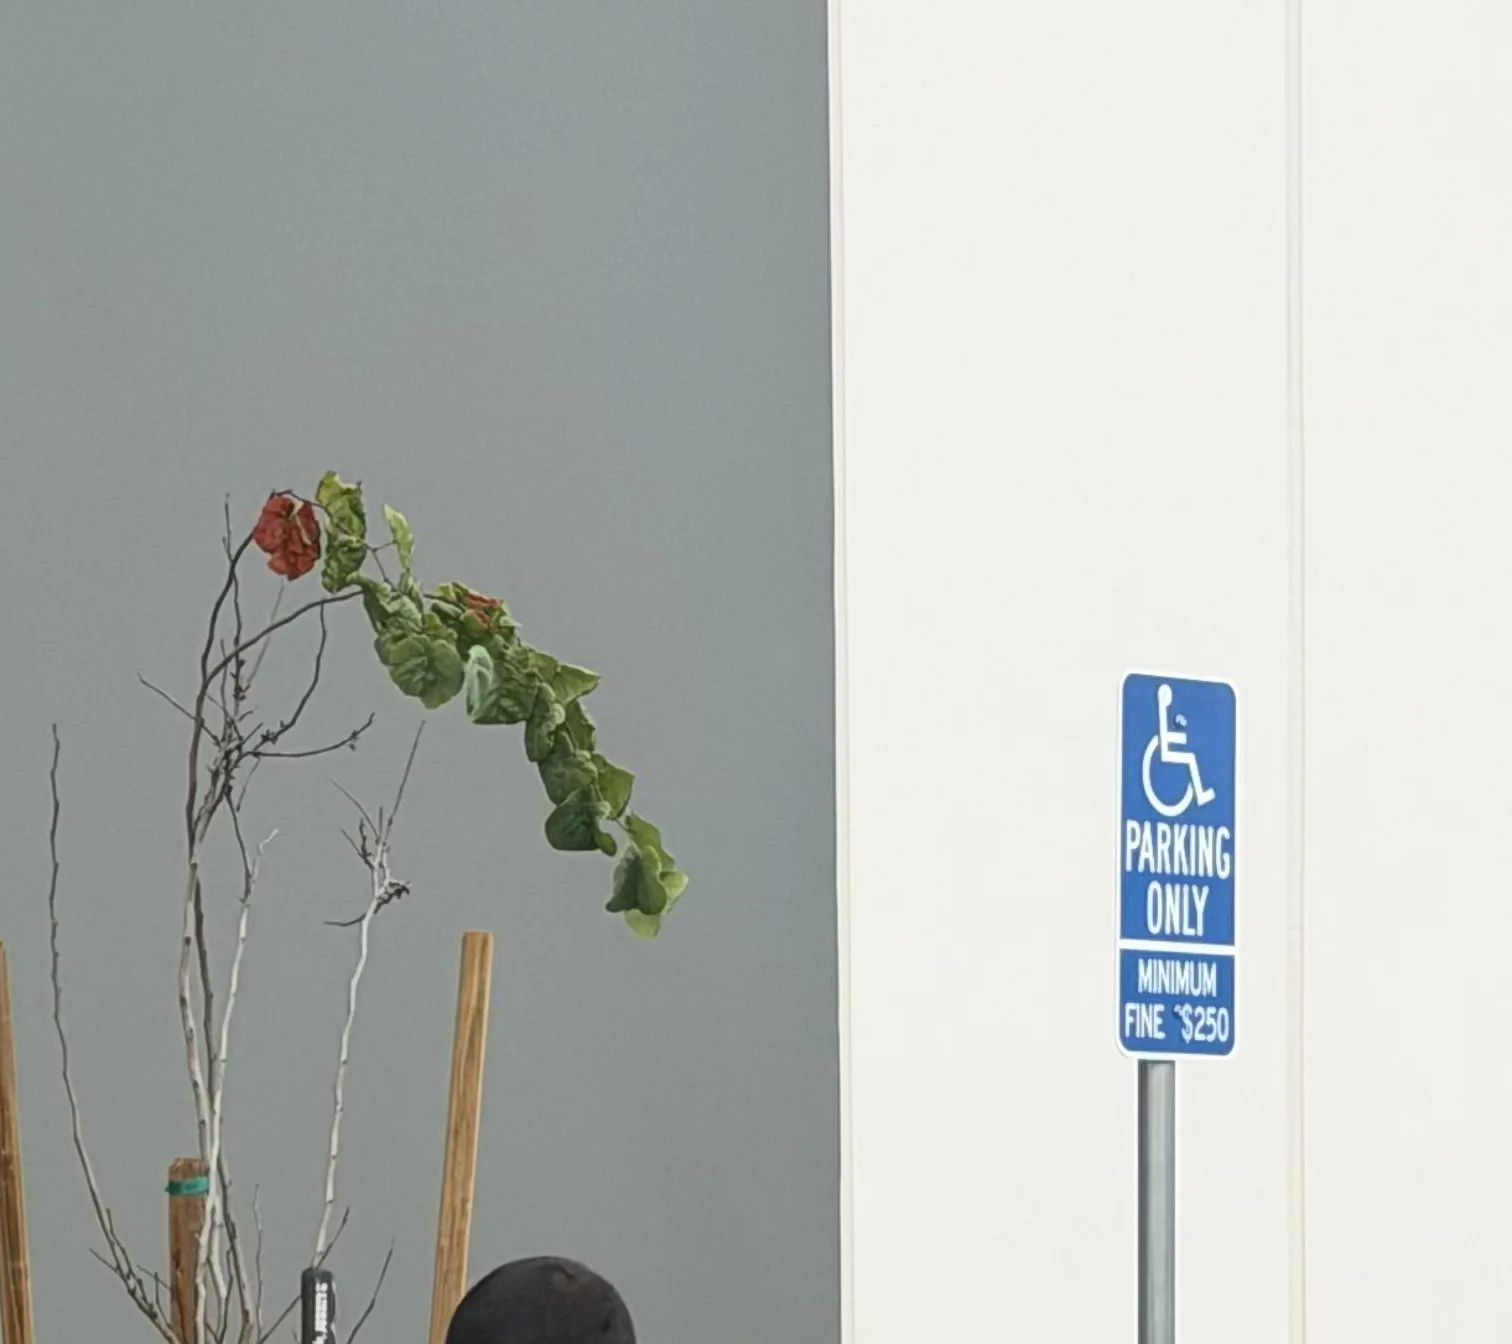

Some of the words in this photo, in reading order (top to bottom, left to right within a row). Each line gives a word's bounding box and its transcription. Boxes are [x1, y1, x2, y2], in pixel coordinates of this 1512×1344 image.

[1125, 819, 1231, 879] PARKING
[1146, 881, 1209, 936] ONLY
[1138, 958, 1218, 997] MINIMUM
[1125, 1002, 1166, 1039] FINE
[1180, 1003, 1229, 1043] $250
